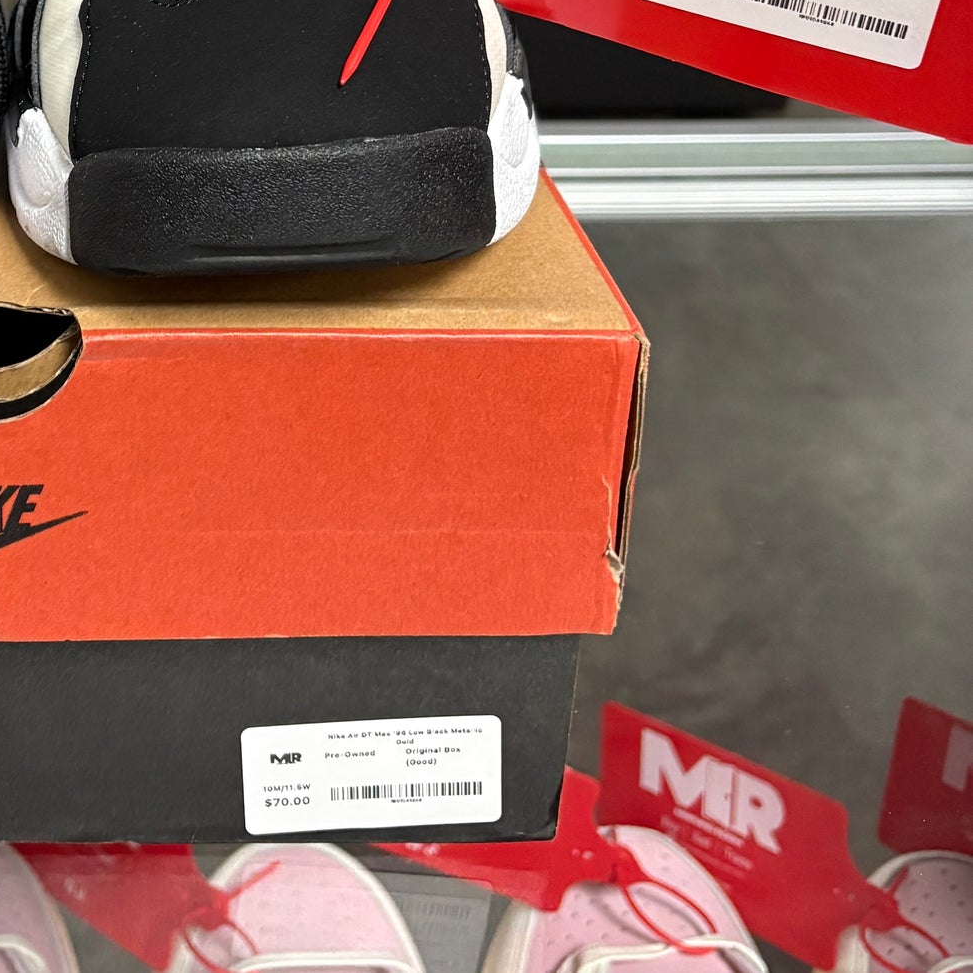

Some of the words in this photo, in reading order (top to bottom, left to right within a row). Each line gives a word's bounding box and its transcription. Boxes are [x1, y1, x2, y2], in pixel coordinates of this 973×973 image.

[324, 749, 376, 759] Pre-Owned
[405, 747, 442, 755] Original
[270, 752, 302, 765] MR
[638, 726, 786, 854] MR
[265, 796, 310, 807] $70.00
